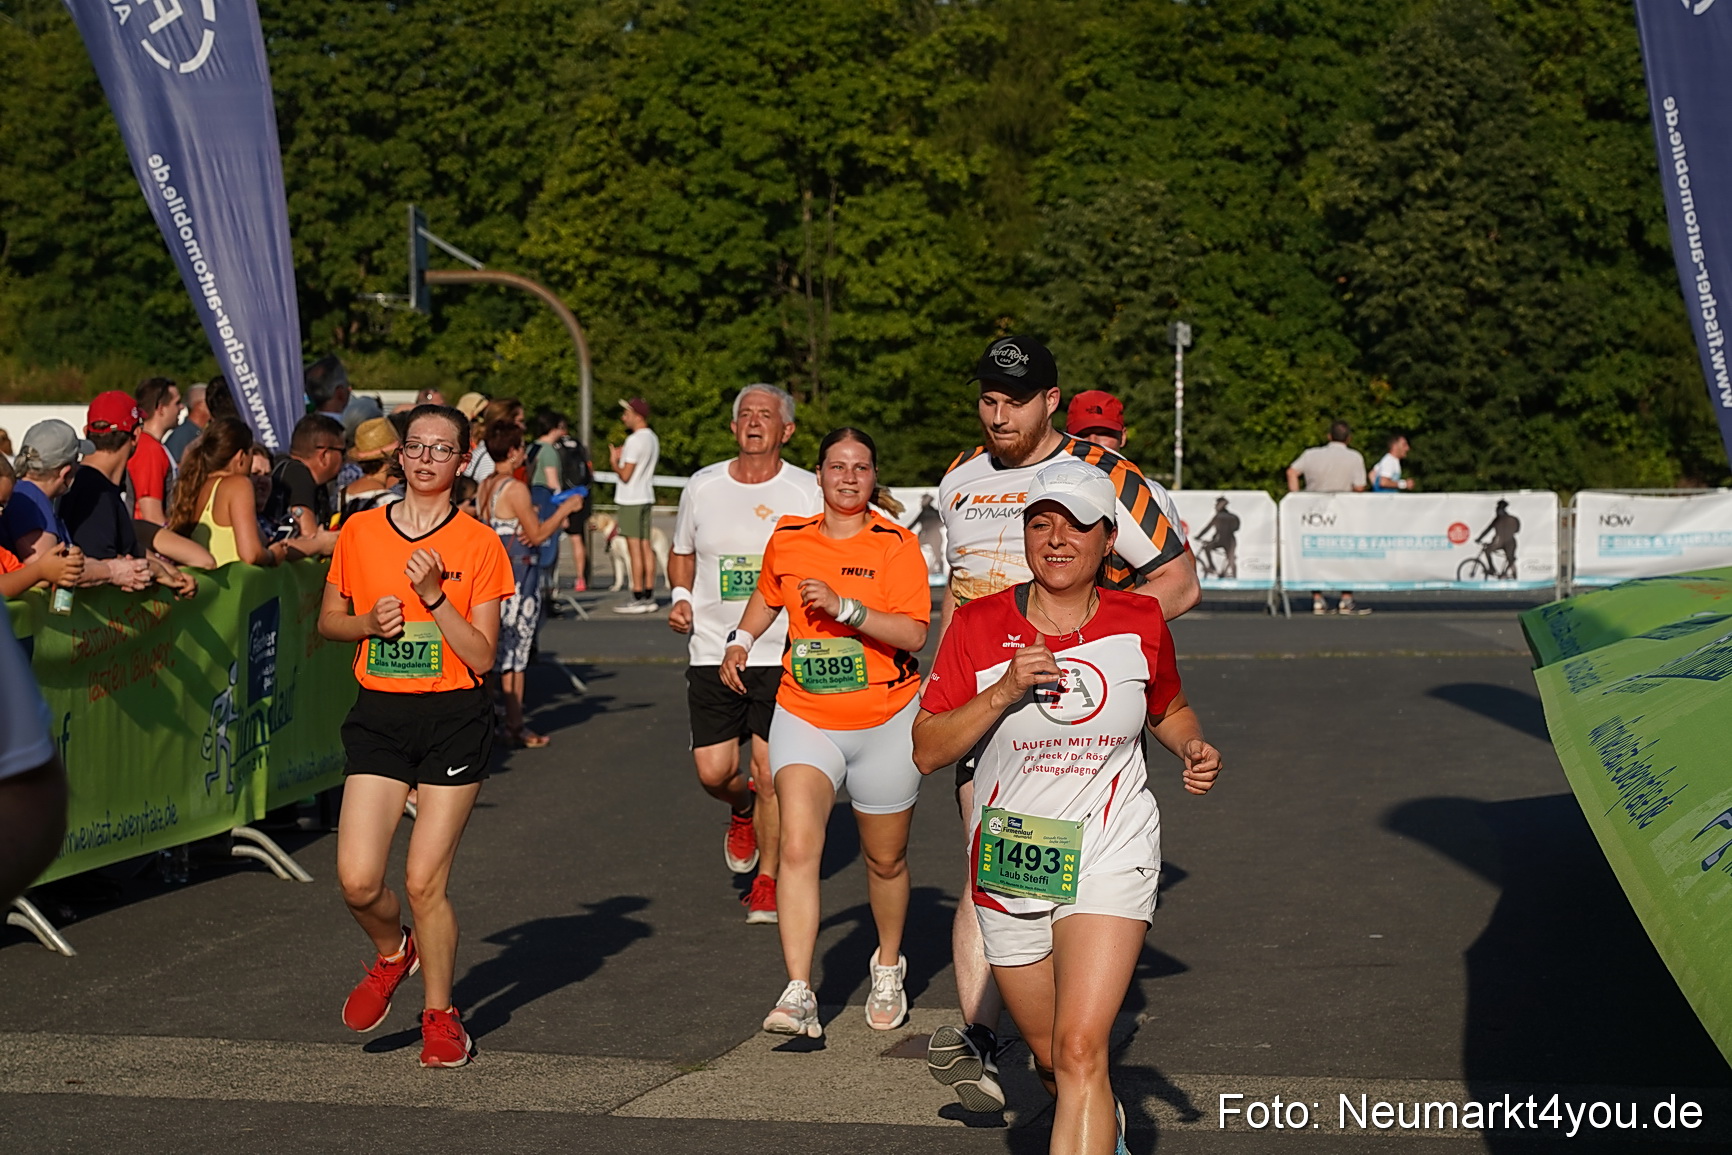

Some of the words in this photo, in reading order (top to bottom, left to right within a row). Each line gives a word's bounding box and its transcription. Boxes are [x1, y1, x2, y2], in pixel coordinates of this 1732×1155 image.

[989, 349, 1009, 357] Hard
[1008, 350, 1029, 364] Rock
[1302, 514, 1336, 526] NOW
[1600, 514, 1634, 527] NOW
[841, 567, 876, 579] THULE
[378, 641, 428, 660] 1397
[430, 644, 438, 670] 2022
[391, 661, 431, 669] Magdalena
[803, 656, 854, 676] 1389
[855, 657, 864, 682] 2022
[1013, 739, 1062, 751] LAUFEN
[1068, 737, 1093, 747] MIT
[1086, 752, 1108, 760] Rösc
[1023, 764, 1099, 776] Leistungsdiagno
[983, 843, 993, 871] RUN
[995, 838, 1060, 874] 1493
[1000, 868, 1020, 880] Laub
[1023, 873, 1049, 885] Steffi
[1061, 854, 1075, 892] 2022
